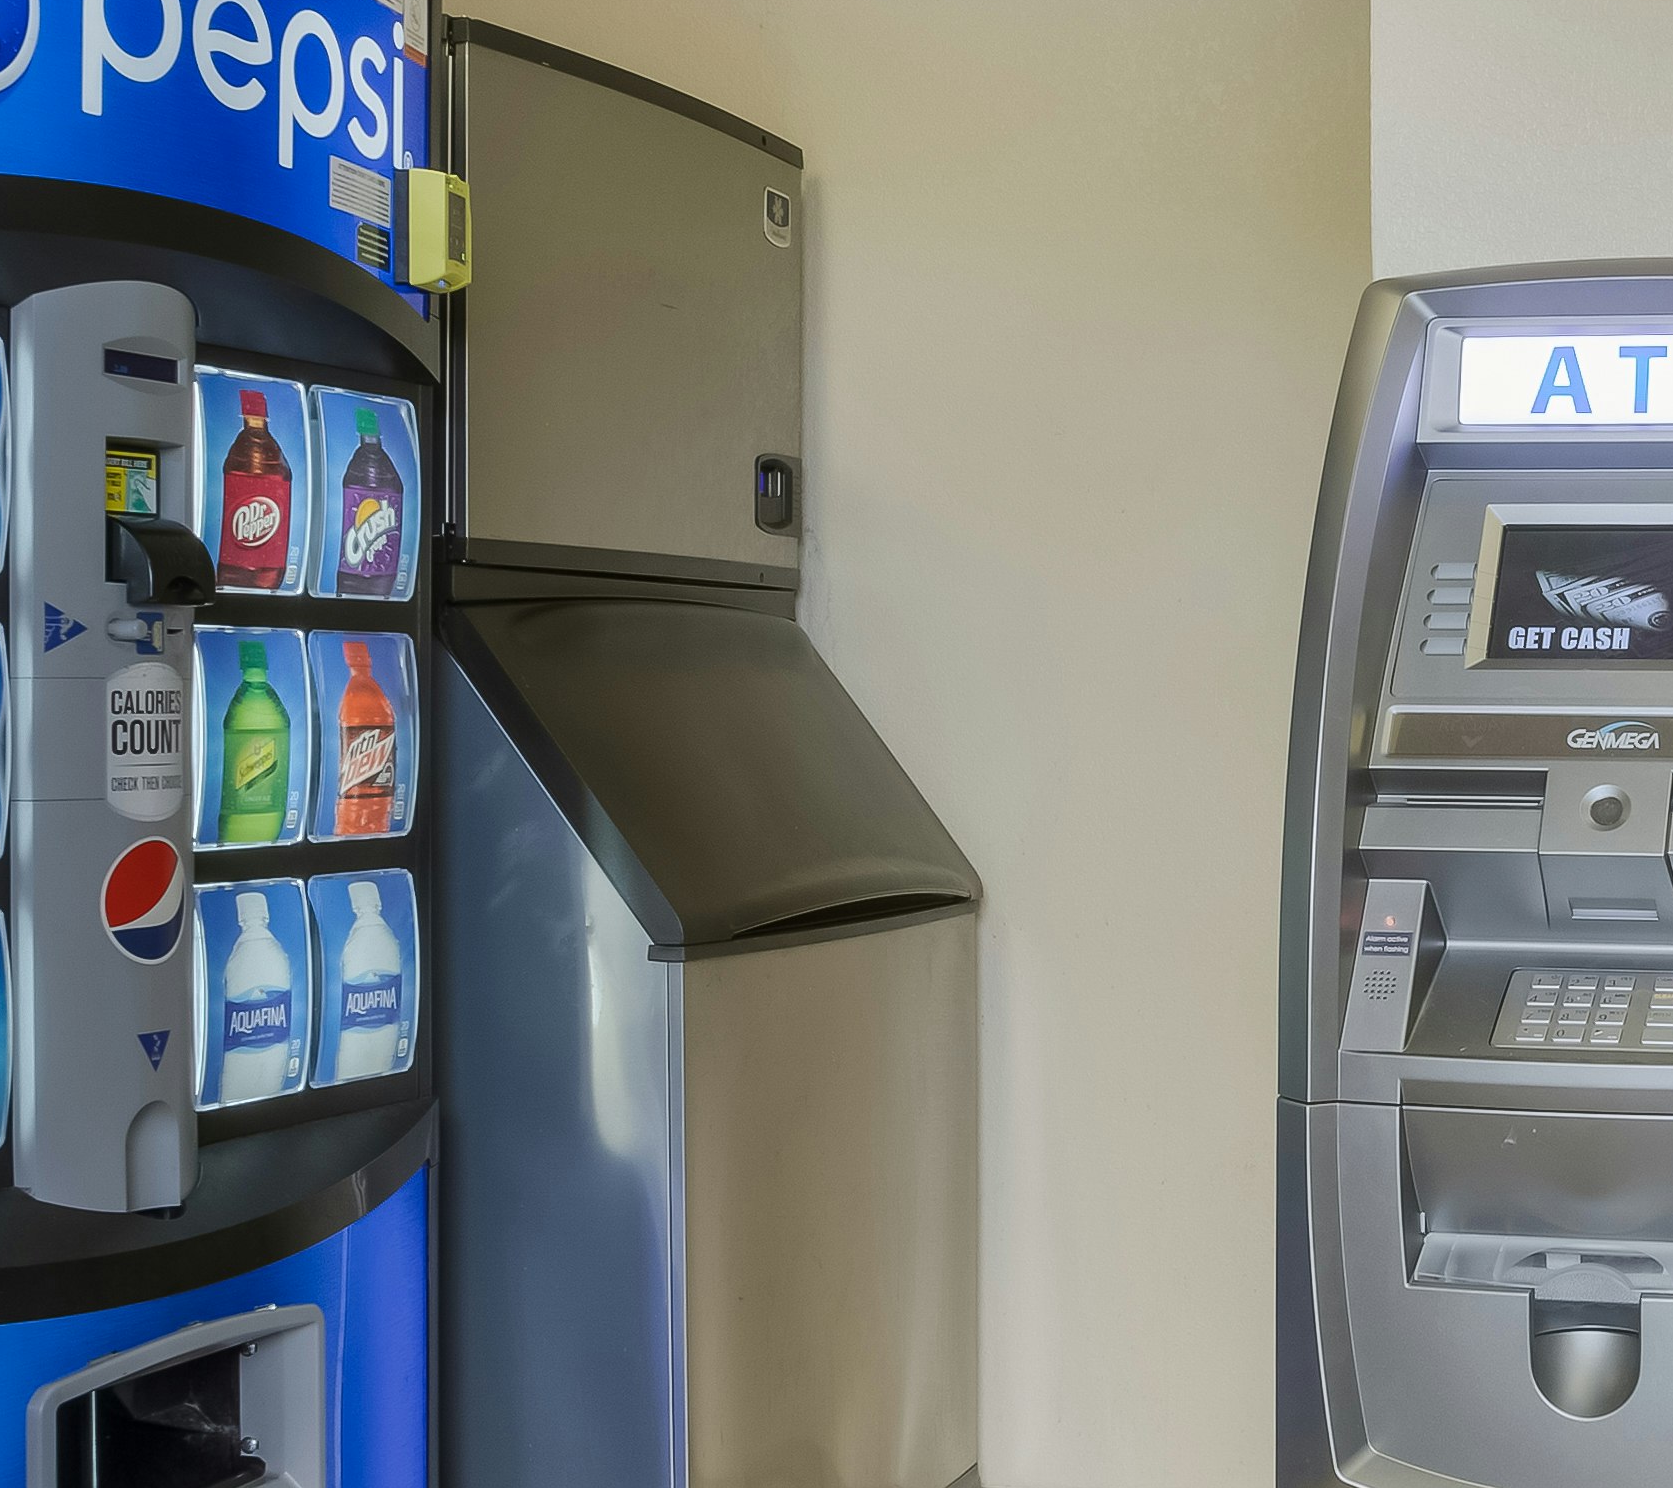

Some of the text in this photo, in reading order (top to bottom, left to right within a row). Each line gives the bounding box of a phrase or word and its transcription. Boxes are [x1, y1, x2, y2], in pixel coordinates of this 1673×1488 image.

[233, 509, 277, 542] Pepper
[1508, 626, 1631, 650] GET CASH
[111, 689, 181, 716] CALORIES
[111, 718, 181, 756] COUNT
[1566, 728, 1661, 751] GENMEGA
[111, 775, 160, 793] CHECK THEN
[1387, 935, 1409, 943] active
[345, 986, 397, 1017] AQUAFINA
[229, 1004, 287, 1037] AQUAFINA
